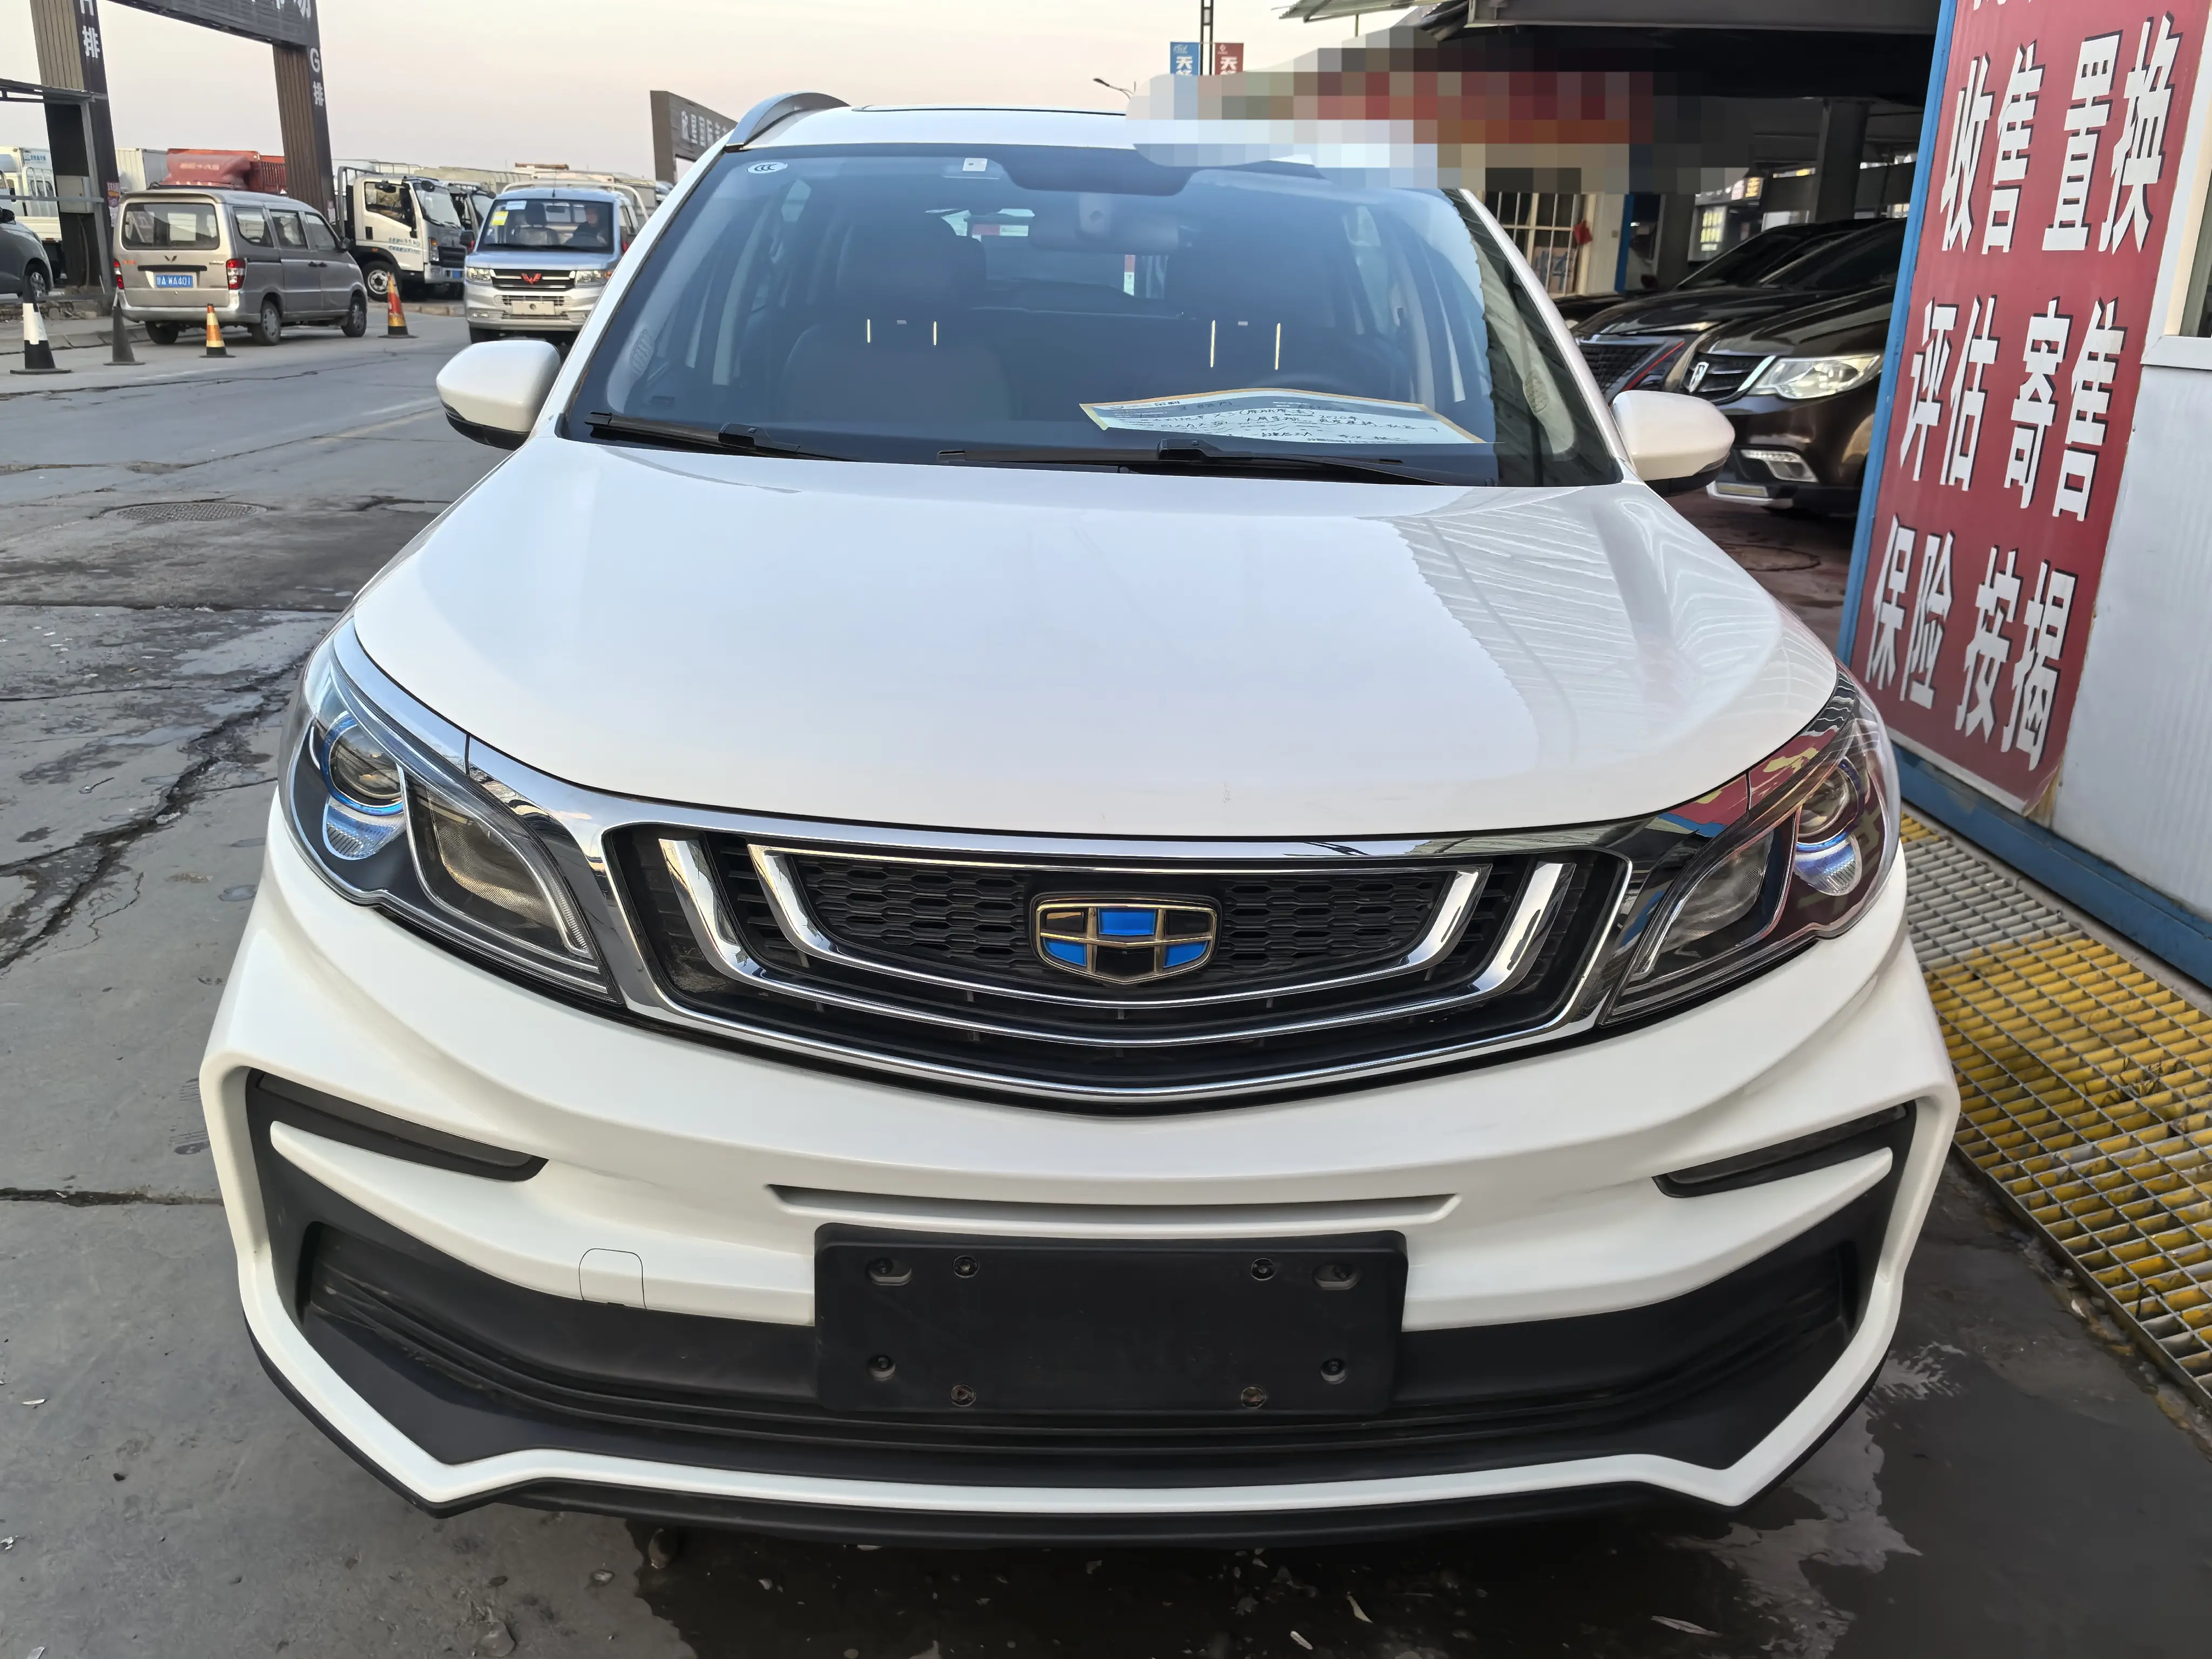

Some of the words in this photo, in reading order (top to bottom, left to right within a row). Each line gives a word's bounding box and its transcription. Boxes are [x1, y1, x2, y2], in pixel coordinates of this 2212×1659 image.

[1940, 41, 2045, 254] 收售
[2042, 12, 2182, 254] 置换
[1900, 297, 1999, 491] 评估
[2004, 297, 2127, 522] 寄售
[1866, 513, 1954, 709] 保险
[1955, 544, 2079, 771] 按揭
